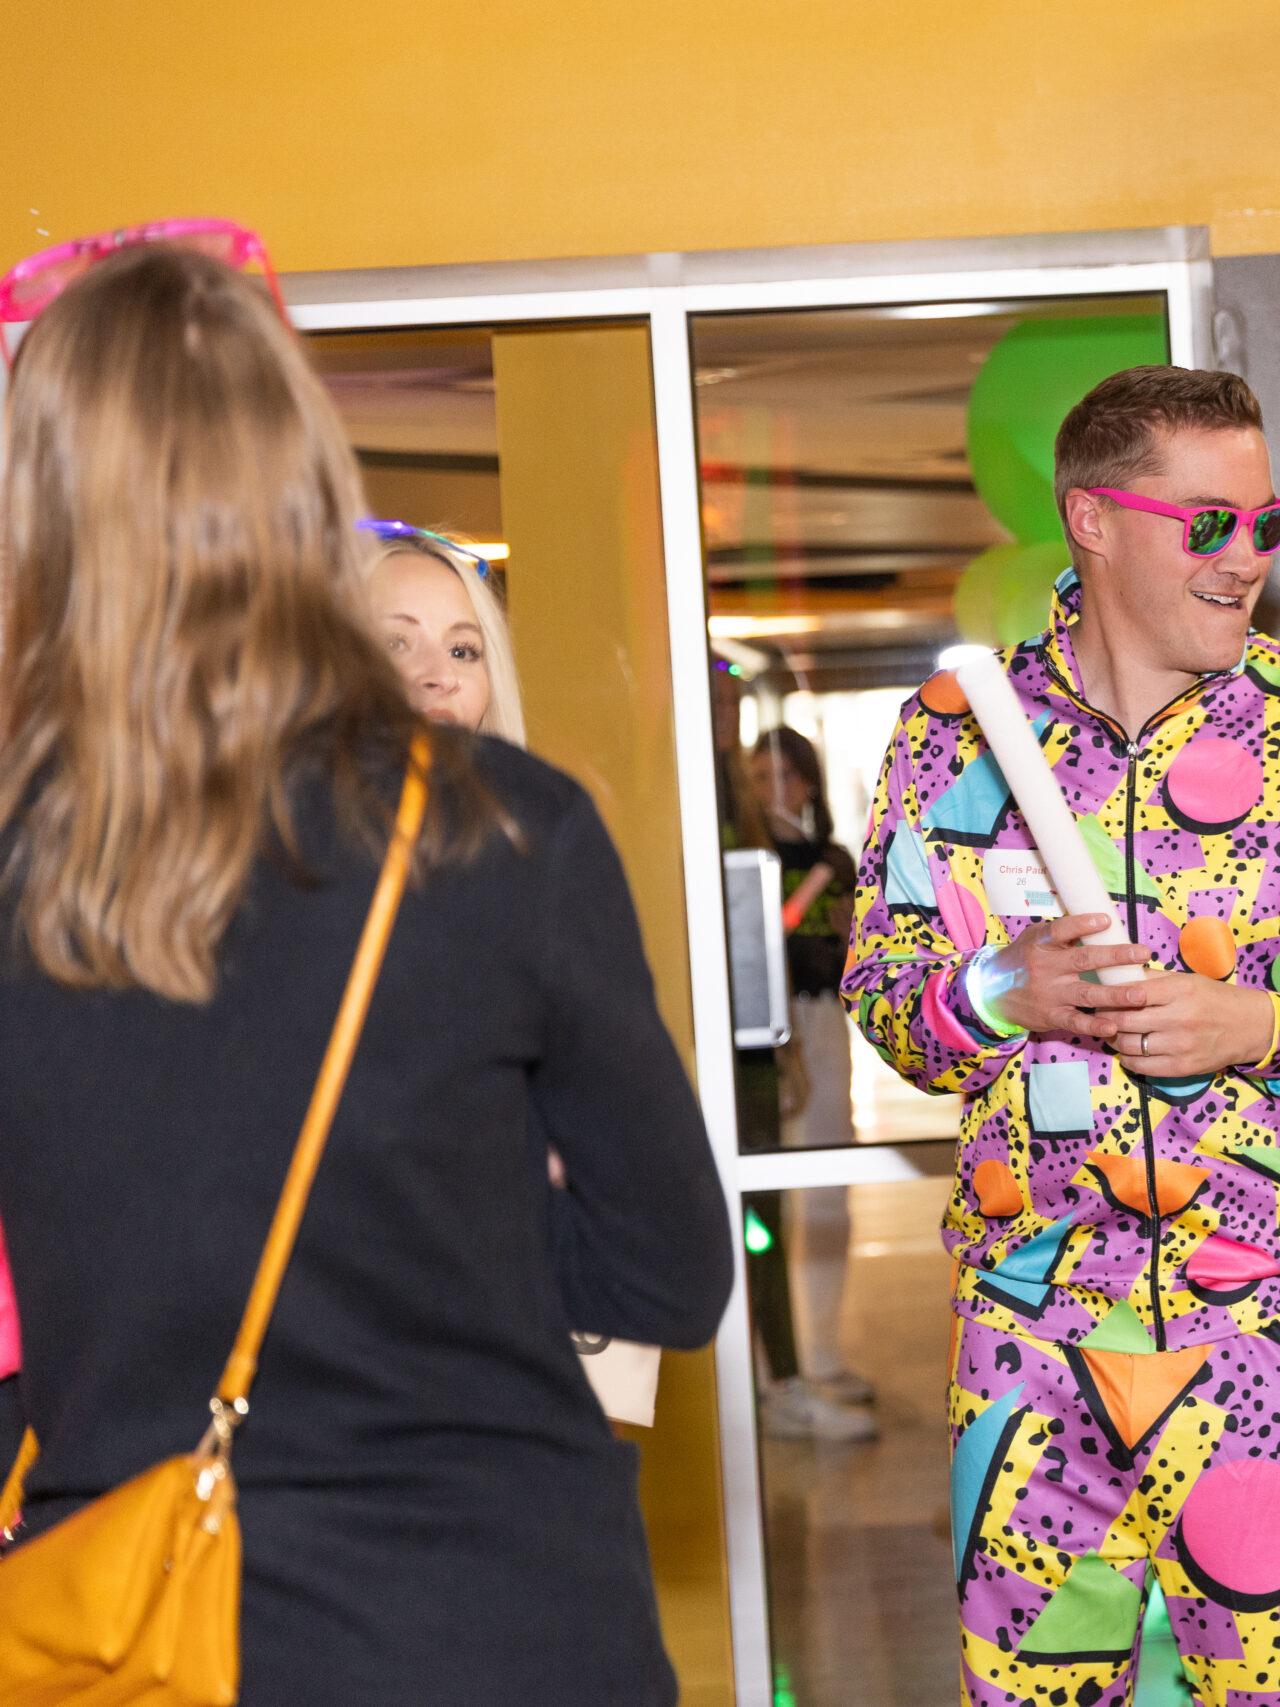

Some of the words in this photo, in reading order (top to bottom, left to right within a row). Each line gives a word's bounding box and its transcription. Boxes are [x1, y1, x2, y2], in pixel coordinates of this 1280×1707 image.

[999, 866, 1023, 874] Chris
[1025, 866, 1047, 875] Paul
[1016, 877, 1027, 886] 26
